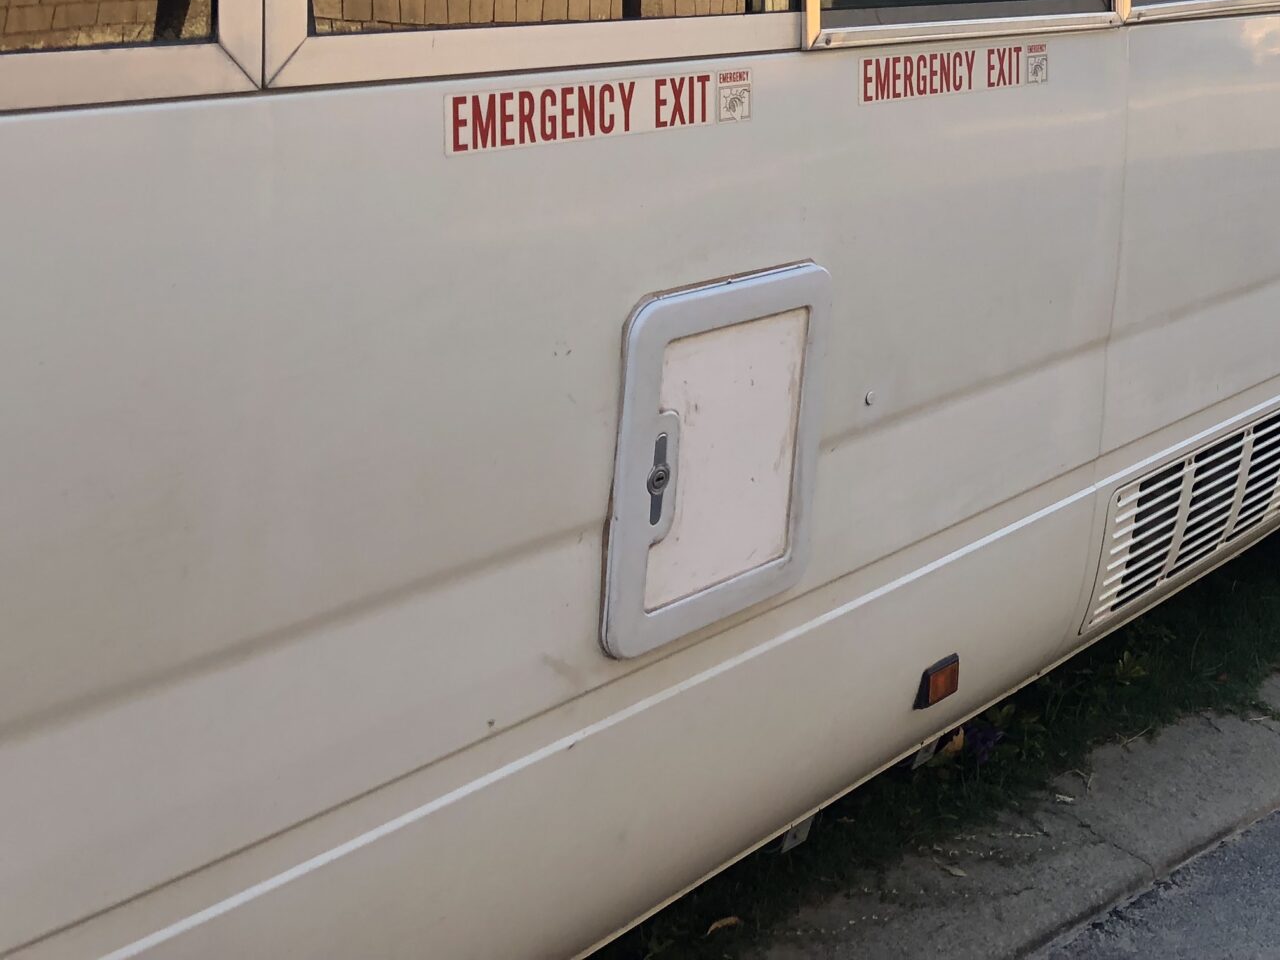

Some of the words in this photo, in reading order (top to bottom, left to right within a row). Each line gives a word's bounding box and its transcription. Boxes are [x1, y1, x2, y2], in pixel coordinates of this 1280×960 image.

[719, 71, 749, 84] EMERGENCY
[863, 50, 976, 102] EMERGENCY
[987, 46, 1022, 88] EXIT
[452, 81, 636, 152] EMERGENCY
[654, 74, 711, 129] EXIT
